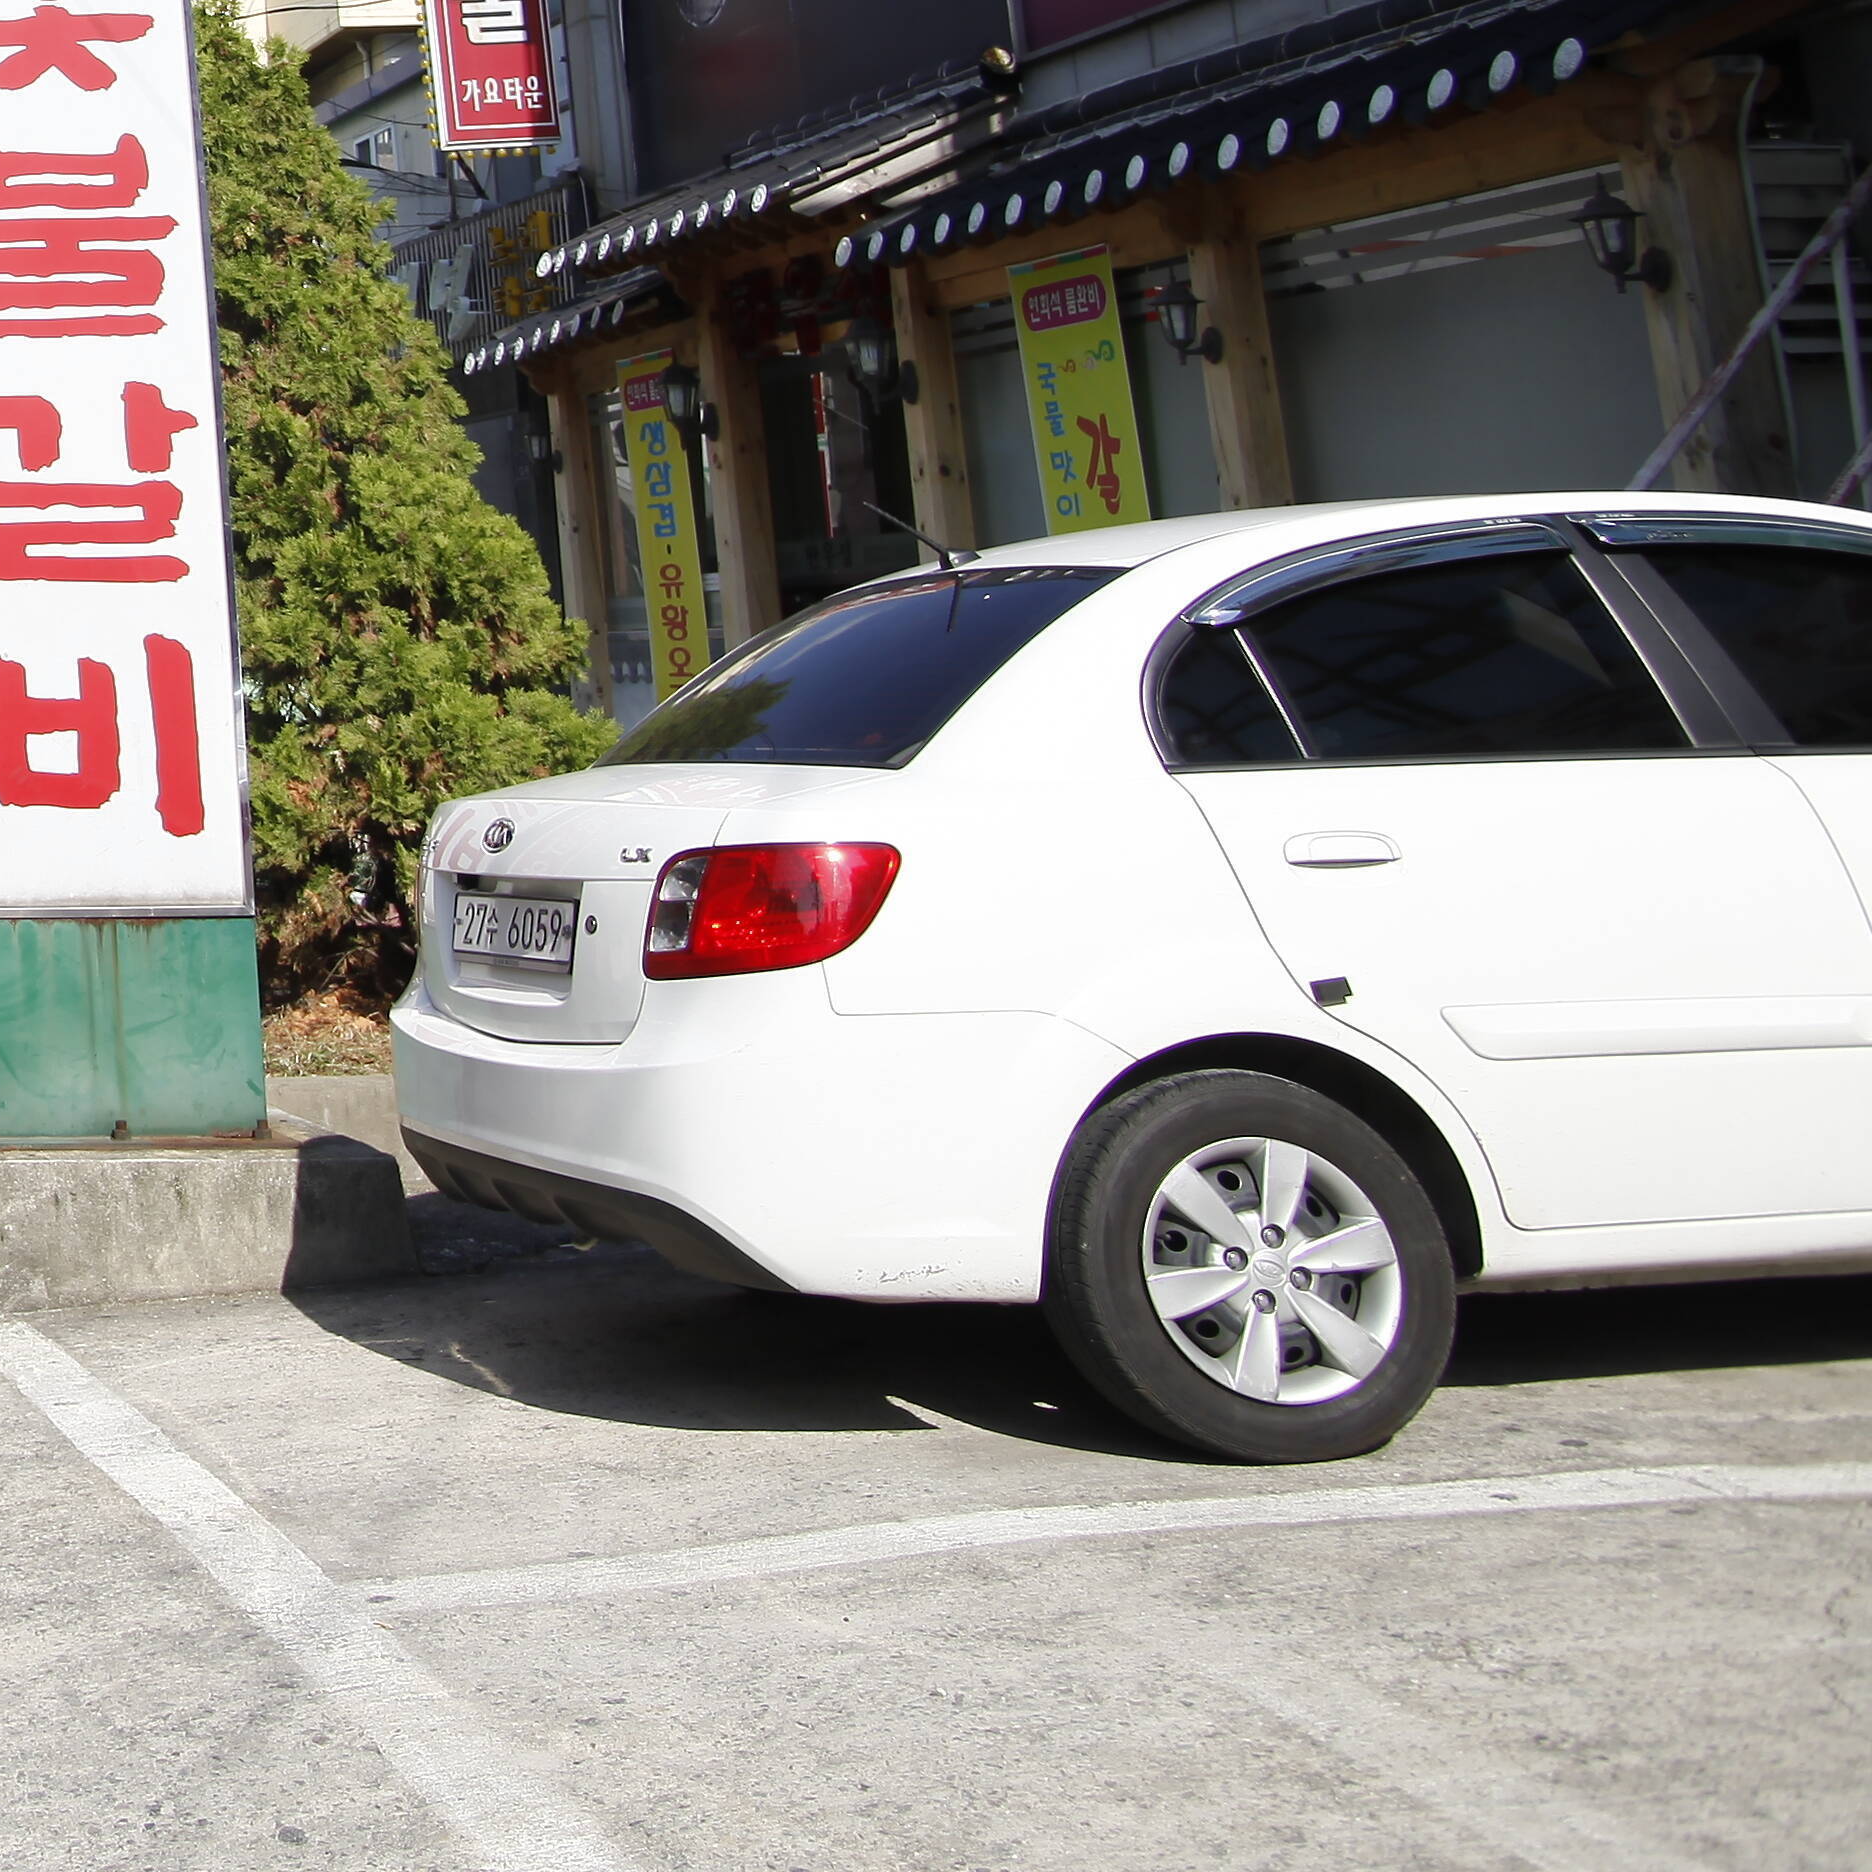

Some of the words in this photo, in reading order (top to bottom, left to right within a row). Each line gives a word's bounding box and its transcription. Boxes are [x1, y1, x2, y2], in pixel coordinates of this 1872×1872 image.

[460, 77, 544, 112] 가요타운
[660, 562, 694, 688] 유황오
[619, 847, 653, 864] LX
[461, 902, 500, 952] 27수
[507, 908, 564, 953] 6059
